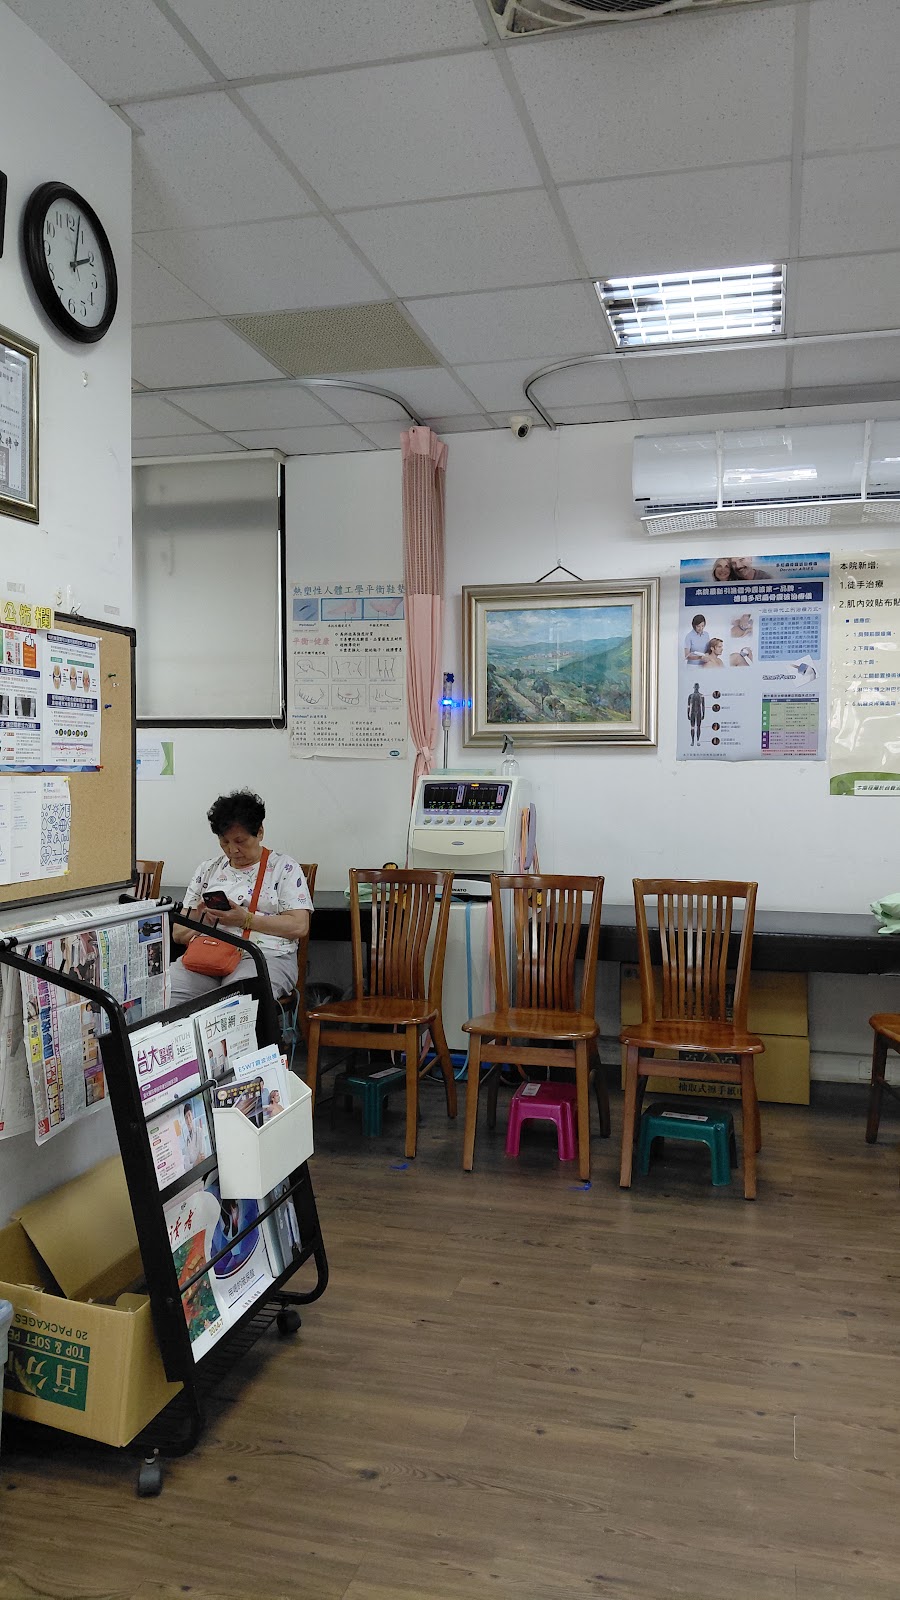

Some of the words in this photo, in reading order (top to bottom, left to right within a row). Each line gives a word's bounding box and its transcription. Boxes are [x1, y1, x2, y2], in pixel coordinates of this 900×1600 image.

[55, 211, 63, 229] 11
[66, 213, 75, 232] 12
[46, 220, 56, 238] 10
[48, 262, 56, 281] 8
[91, 273, 98, 290] 3
[68, 298, 76, 315] 6
[87, 291, 95, 306] 4
[80, 300, 87, 318] 5
[840, 561, 879, 570] 本院新增:
[840, 580, 884, 590] 1.徒手治療
[4, 601, 52, 629] 公佈欄
[174, 1032, 190, 1044] NTUH
[14, 1313, 73, 1337] PACKAGES
[25, 1334, 51, 1350] SOFT
[75, 1331, 89, 1341] 20
[54, 1342, 63, 1354] &
[65, 1347, 85, 1360] TOP
[9, 1351, 78, 1396] 百分
